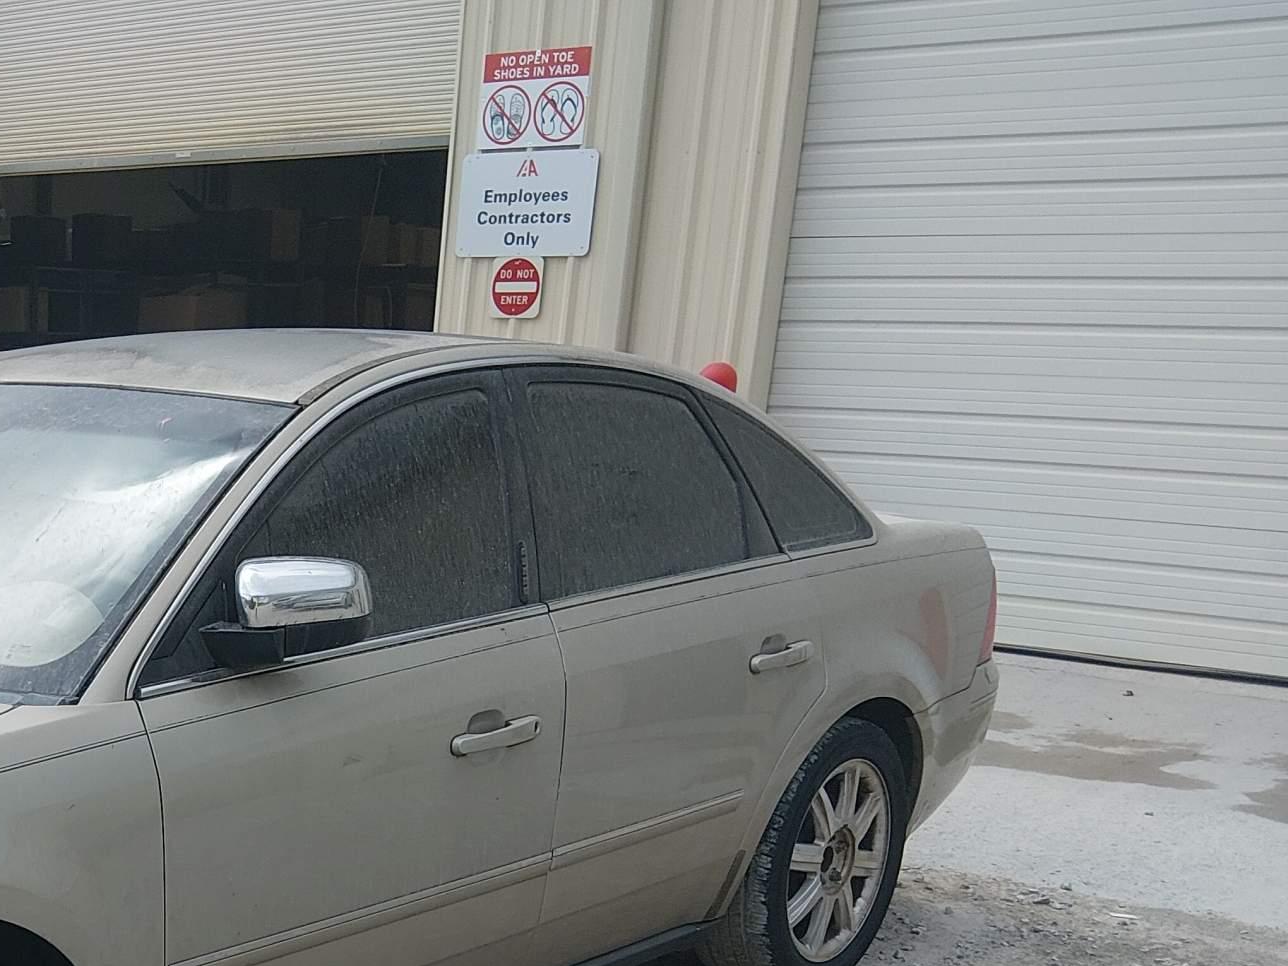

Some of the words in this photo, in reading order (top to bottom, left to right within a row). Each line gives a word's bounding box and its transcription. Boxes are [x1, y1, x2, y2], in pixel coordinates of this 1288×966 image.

[500, 56, 516, 67] NO
[518, 52, 549, 66] OPEN
[552, 51, 574, 63] TOE
[493, 68, 530, 80] SHOES
[533, 66, 545, 77] IN
[548, 64, 579, 76] YARD
[483, 188, 569, 206] Employees
[477, 211, 572, 225] Contractors
[503, 231, 540, 248] Only
[500, 269, 513, 279] DO
[516, 269, 535, 279] NOT
[500, 295, 529, 305] ENTER
